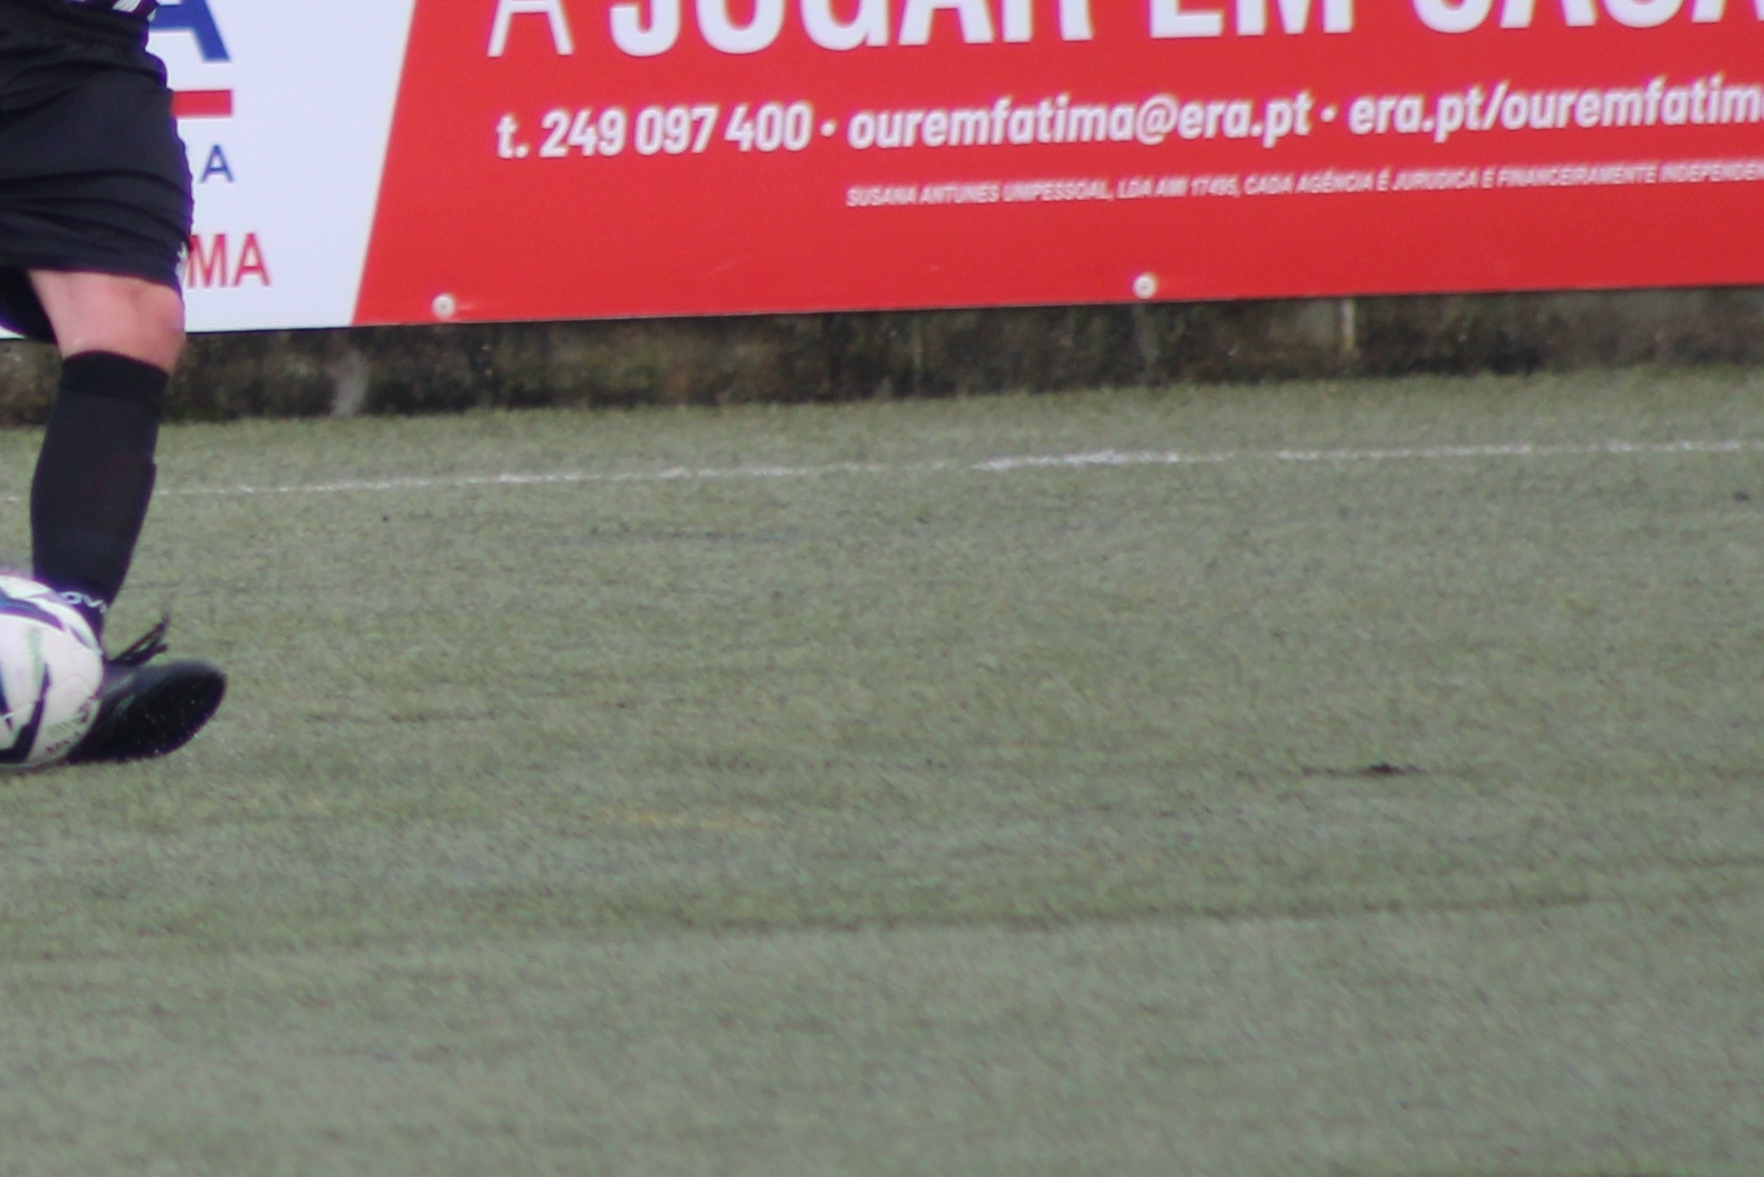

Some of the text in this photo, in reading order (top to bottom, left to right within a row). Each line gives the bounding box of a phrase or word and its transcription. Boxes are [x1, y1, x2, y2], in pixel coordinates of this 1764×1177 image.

[496, 72, 1764, 159] t. 249 097 400 ouremfatima@era.pt era.pt/ouremfatim
